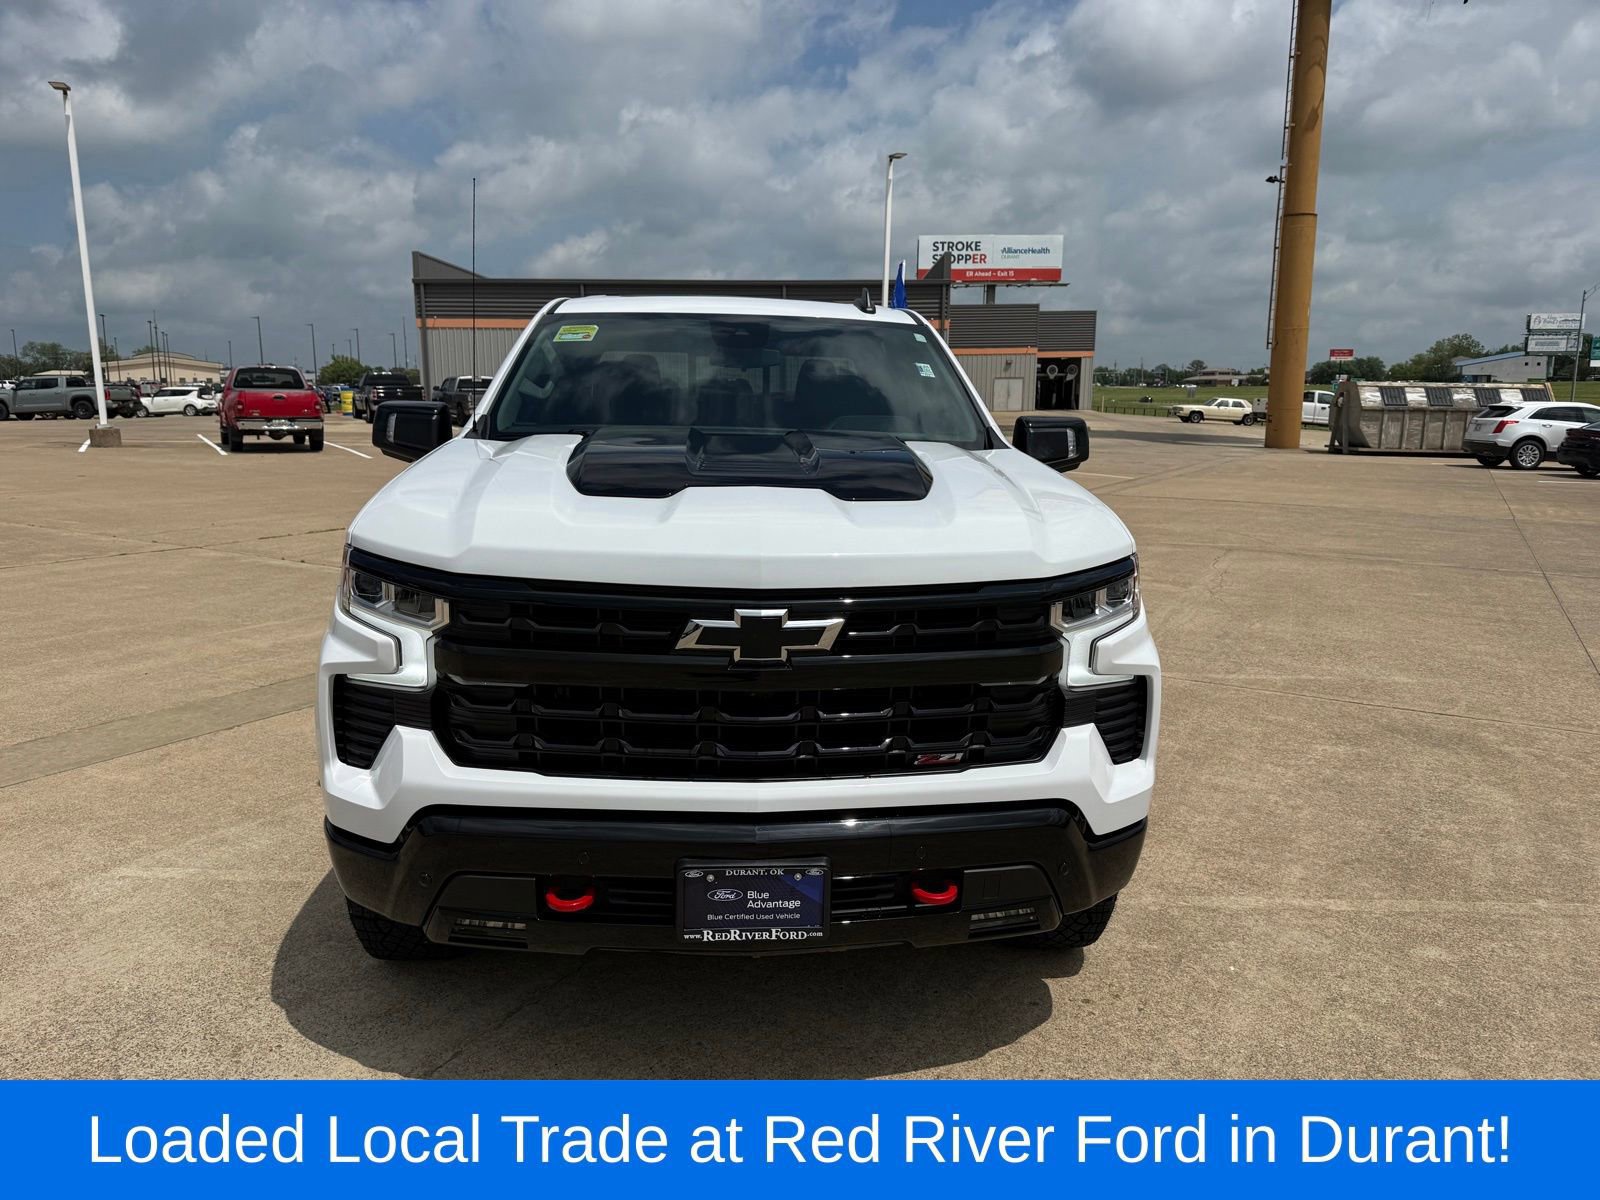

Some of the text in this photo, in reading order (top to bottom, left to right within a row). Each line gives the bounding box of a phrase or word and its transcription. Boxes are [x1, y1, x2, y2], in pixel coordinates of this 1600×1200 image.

[932, 241, 981, 251] STROKE
[1001, 247, 1050, 255] AllianceHealth
[932, 254, 987, 264] SOPPER
[770, 868, 784, 876] OK
[714, 890, 736, 899] Ford
[747, 891, 770, 899] Blue
[747, 899, 801, 909] Advantage
[775, 912, 800, 920] Vehicle
